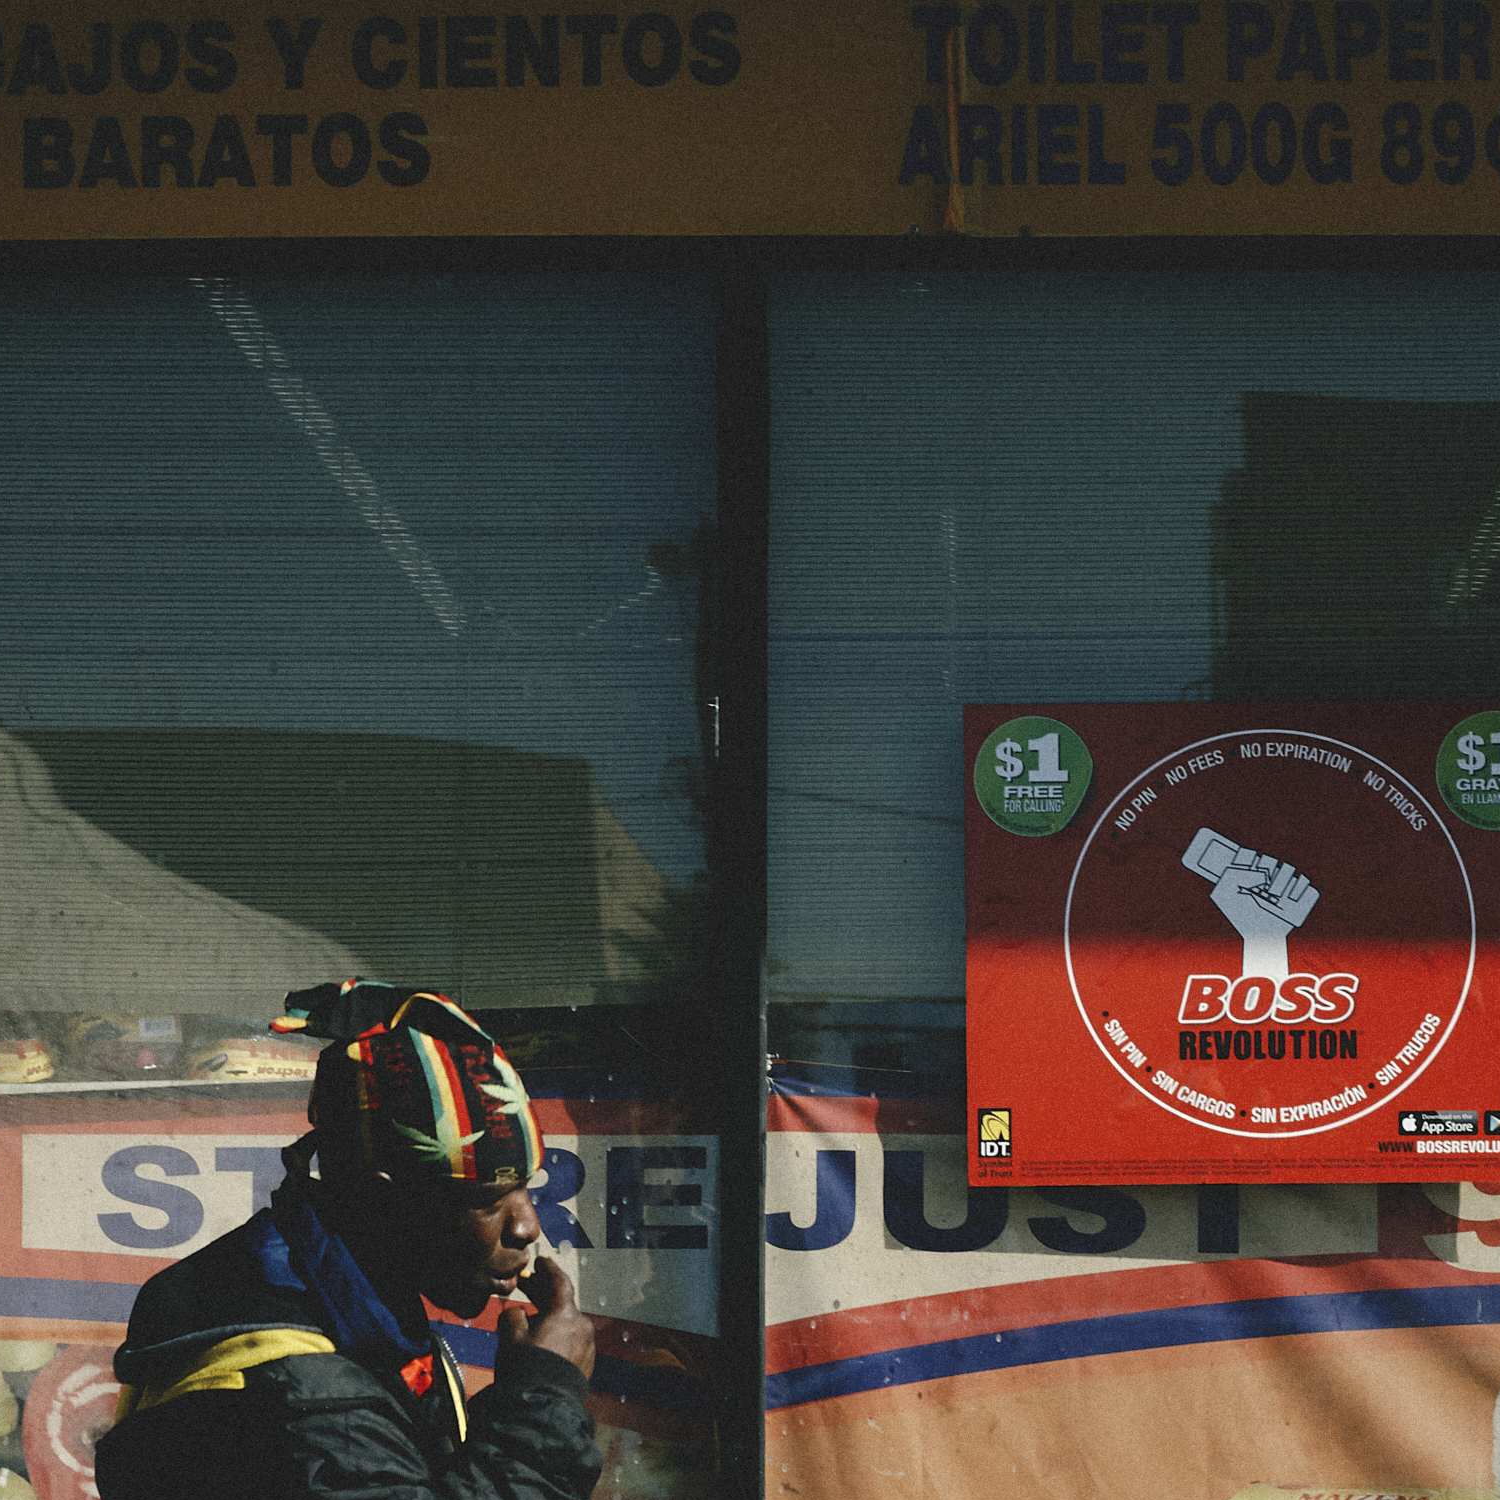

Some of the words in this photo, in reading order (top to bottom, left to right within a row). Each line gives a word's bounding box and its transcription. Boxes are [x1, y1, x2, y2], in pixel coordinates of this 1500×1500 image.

[266, 20, 326, 90] Y
[352, 11, 742, 90] CIENTOS
[912, 0, 1201, 87] TOILET
[1227, 0, 1494, 84] PAPER
[23, 111, 431, 191] BARATOS
[902, 104, 1127, 187] ARIEL
[1151, 101, 1353, 187] 500G
[994, 732, 1069, 783] $1
[1164, 764, 1189, 787] NO
[1187, 748, 1226, 775] FEES
[1240, 742, 1263, 759] NO
[1265, 741, 1353, 774] EXPIRATION
[1004, 785, 1063, 799] FREE
[1004, 799, 1022, 813] FOR
[1114, 809, 1137, 831] NO
[1134, 786, 1159, 815] PIN
[1362, 769, 1387, 792] NO
[1384, 784, 1429, 833] TRICKS
[1461, 793, 1474, 805] EN
[1177, 972, 1360, 1025] BOSS
[1103, 1018, 1129, 1047] SIN
[1120, 1040, 1149, 1069] PIN
[1179, 1028, 1358, 1060] REVOLUTION
[1374, 1059, 1403, 1087] SIN
[1394, 1012, 1442, 1067] TRUCOS
[1151, 1069, 1180, 1095] SIN
[1176, 1084, 1237, 1120] CARGOS
[1251, 1106, 1278, 1124] SIN
[1279, 1083, 1368, 1124] EXPIRACIÓN
[980, 1141, 1010, 1157] IDT
[1421, 1121, 1445, 1135] App
[1445, 1121, 1474, 1132] Store
